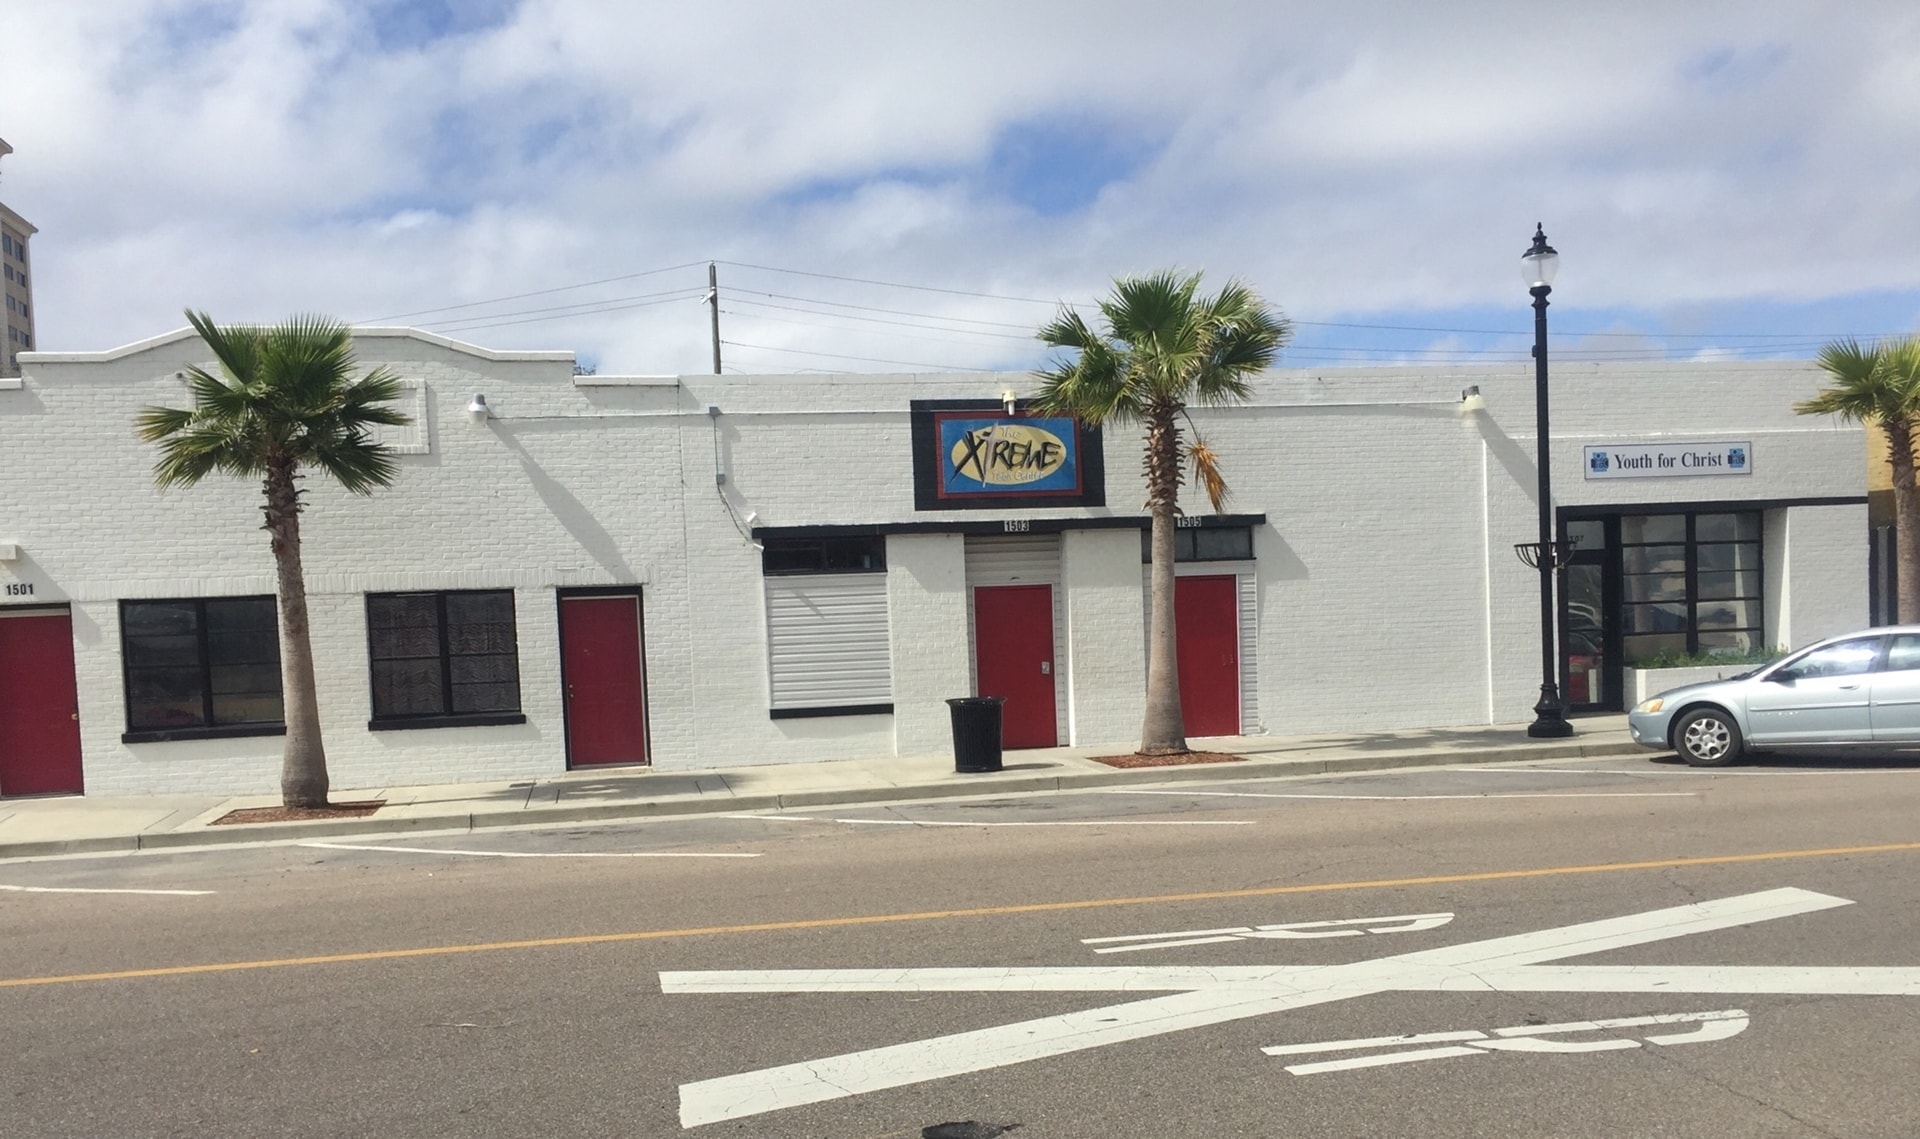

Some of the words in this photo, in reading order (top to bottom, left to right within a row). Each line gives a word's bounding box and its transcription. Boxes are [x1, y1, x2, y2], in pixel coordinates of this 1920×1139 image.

[1614, 453, 1653, 470] Youth
[1657, 452, 1677, 469] for
[1681, 451, 1723, 469] Christ
[1004, 519, 1029, 532] 1503
[1177, 515, 1202, 528] 1505
[6, 583, 35, 596] 1501
